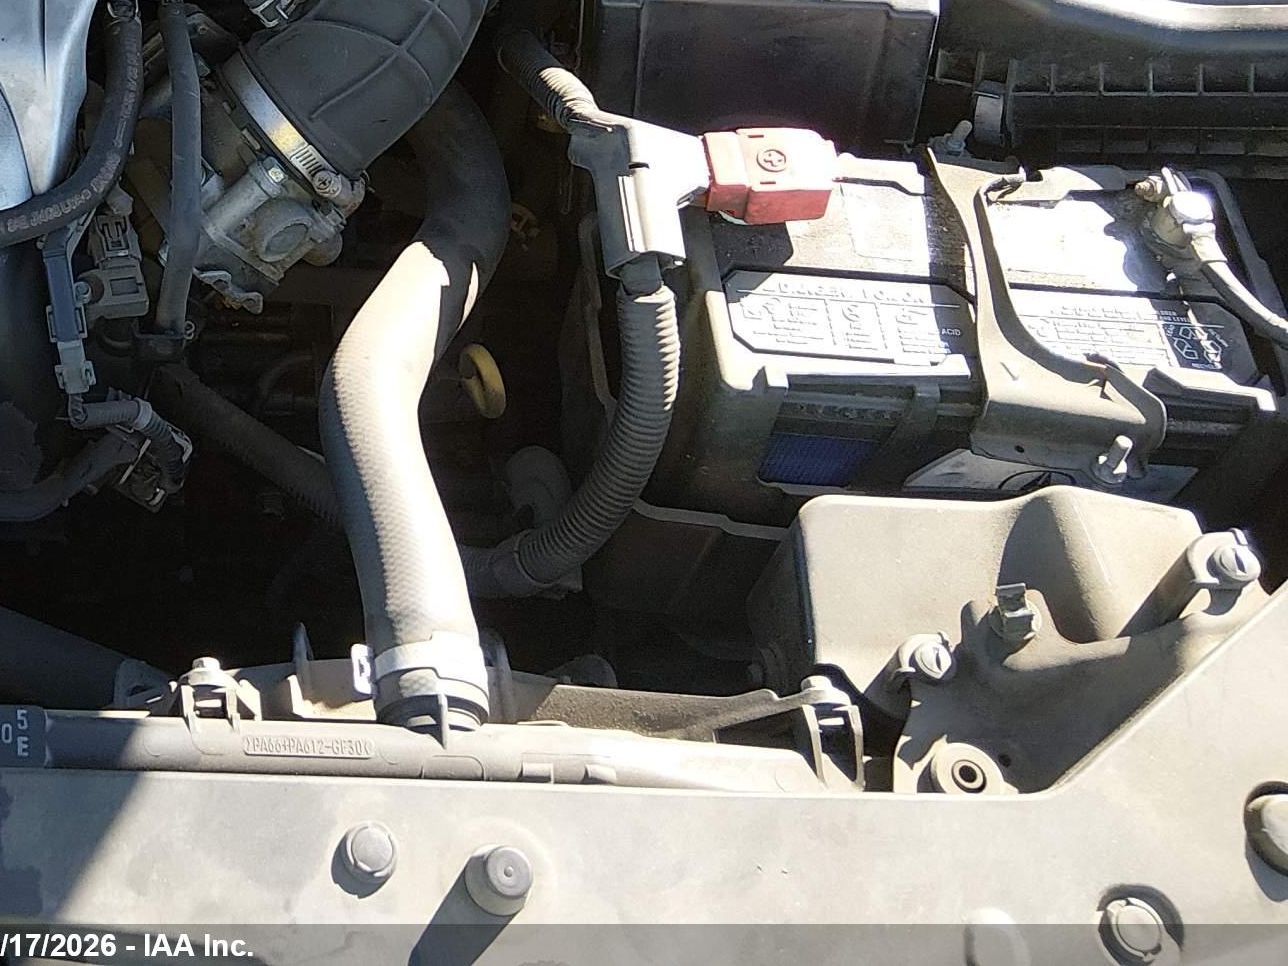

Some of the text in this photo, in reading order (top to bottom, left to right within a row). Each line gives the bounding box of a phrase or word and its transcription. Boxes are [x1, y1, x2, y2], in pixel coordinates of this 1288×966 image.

[941, 328, 961, 336] ACID
[16, 709, 29, 730] 5
[17, 736, 30, 756] E
